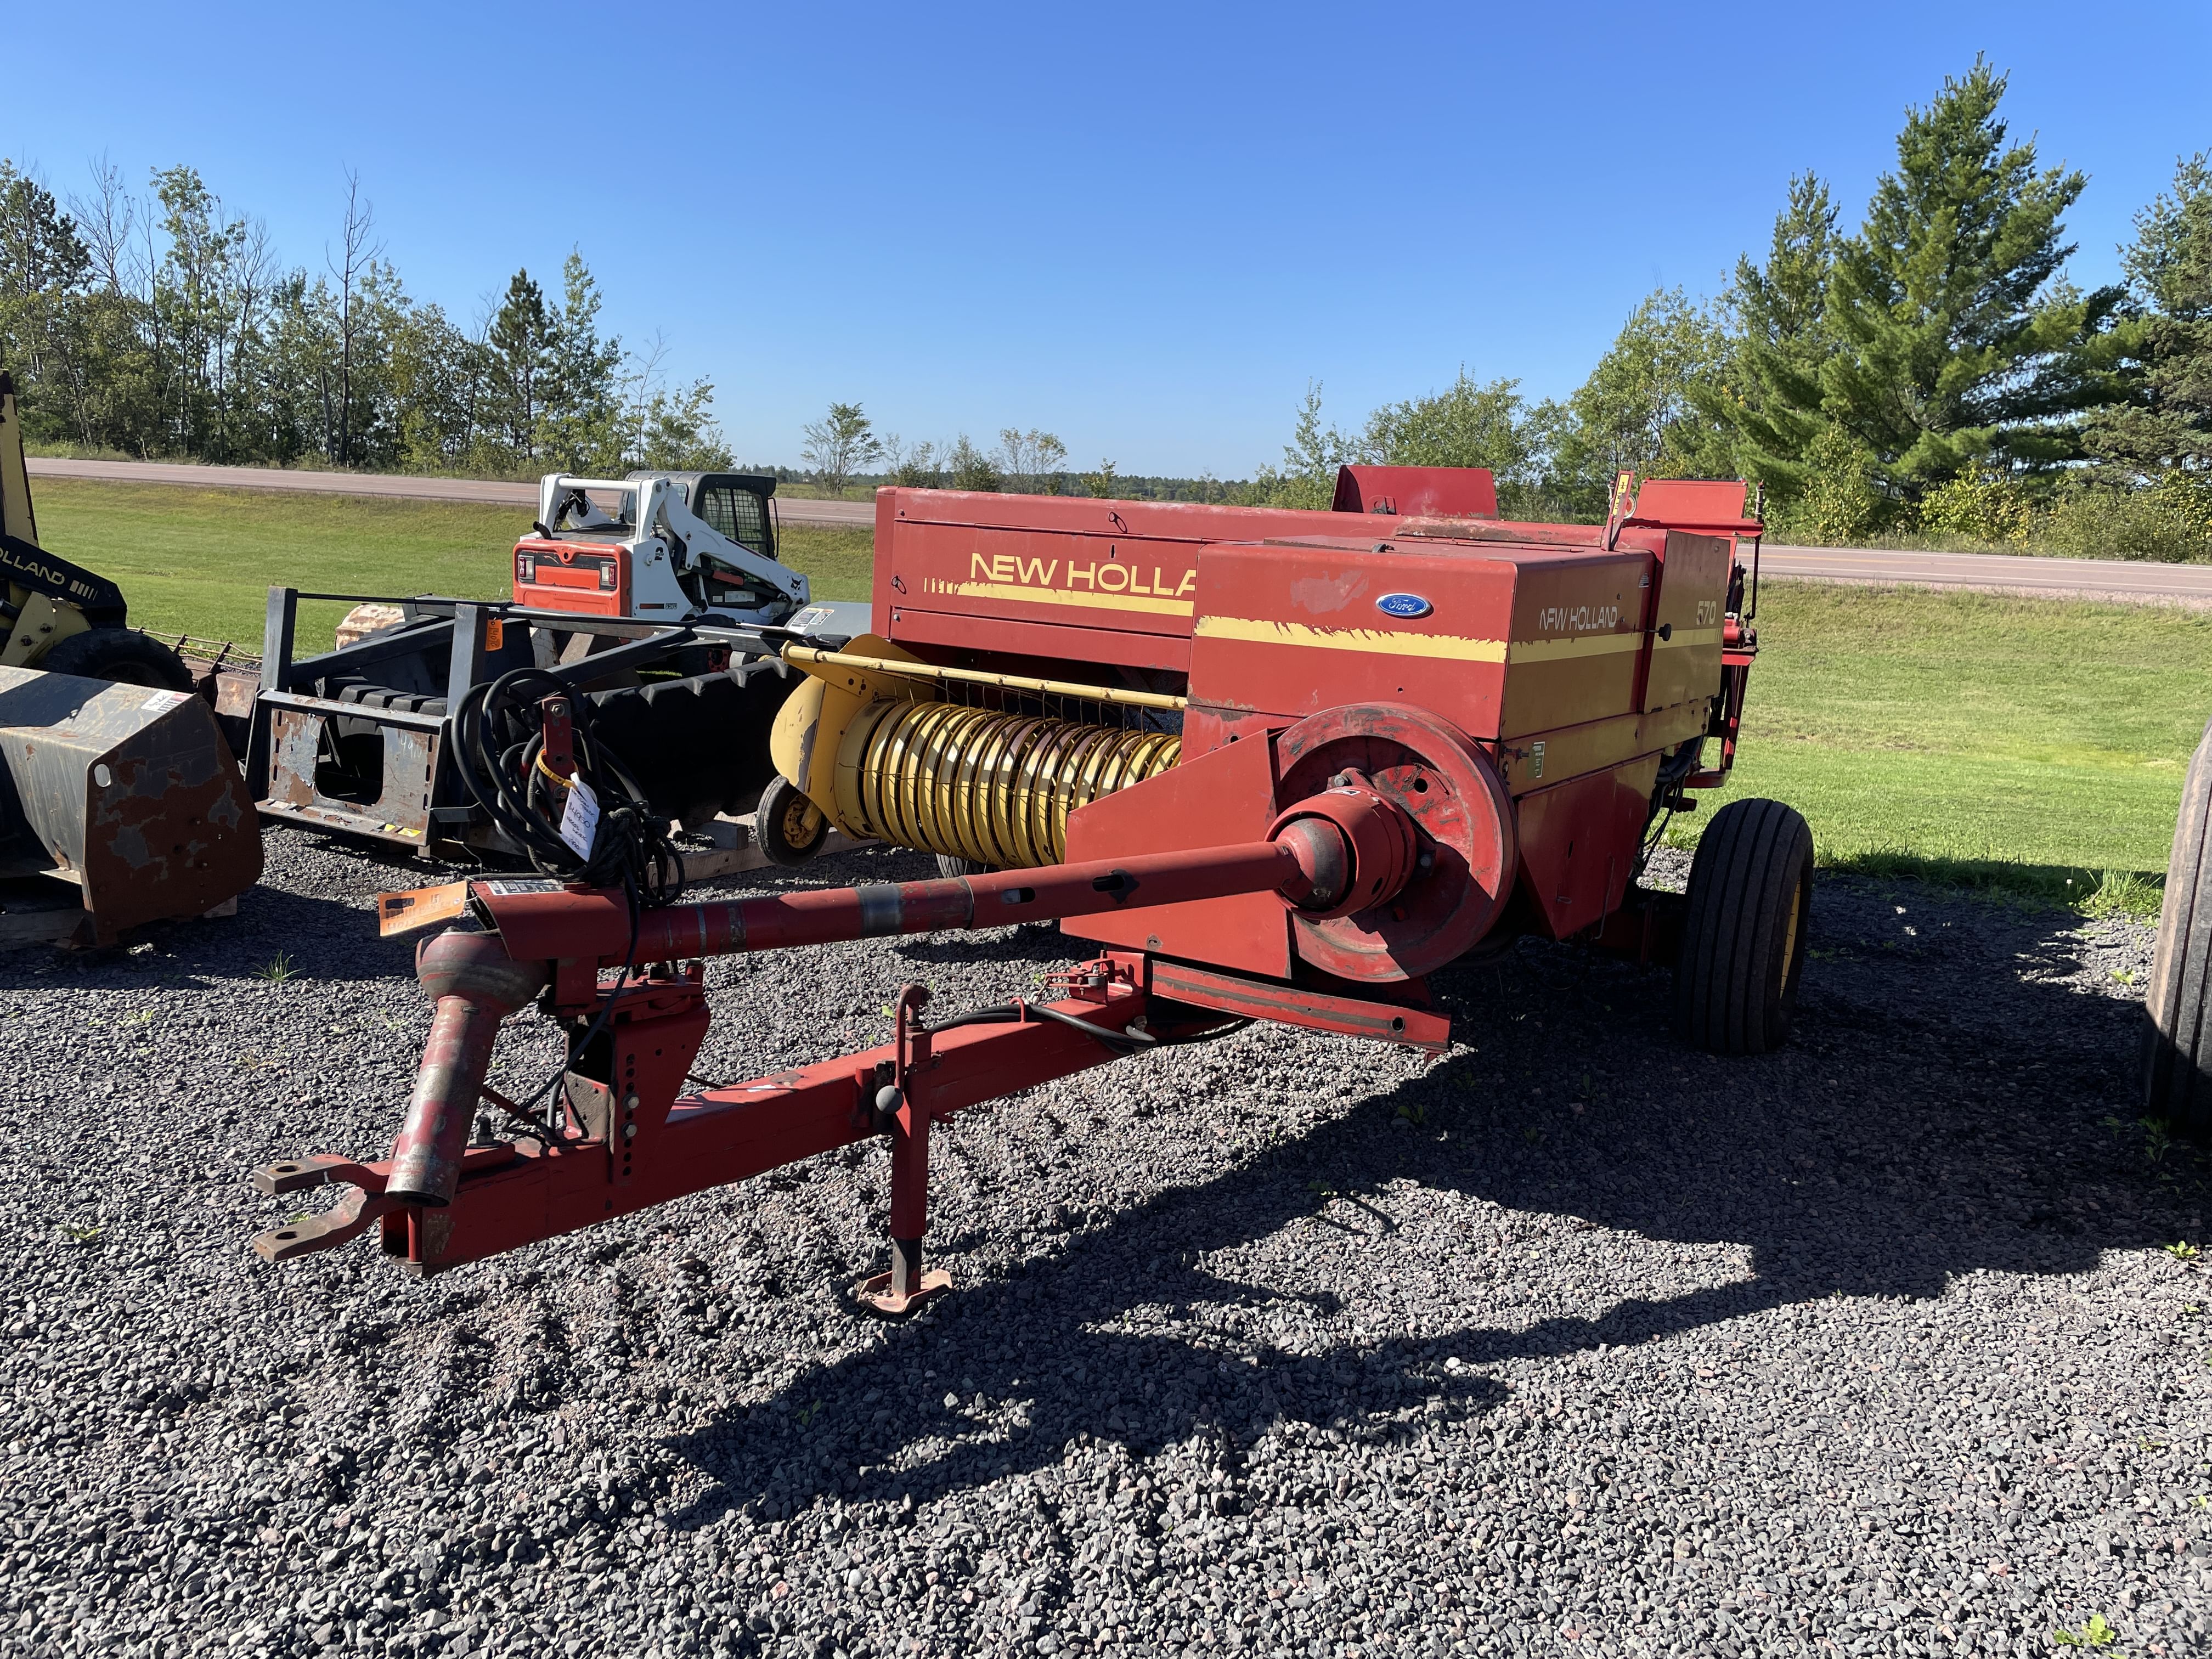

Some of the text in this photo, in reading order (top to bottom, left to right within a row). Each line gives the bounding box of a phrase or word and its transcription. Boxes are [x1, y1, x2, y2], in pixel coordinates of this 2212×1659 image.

[970, 552, 1058, 585] NEW
[1389, 597, 1417, 612] Ford
[1696, 601, 1717, 625] 570
[1568, 606, 1618, 631] HOLLAND
